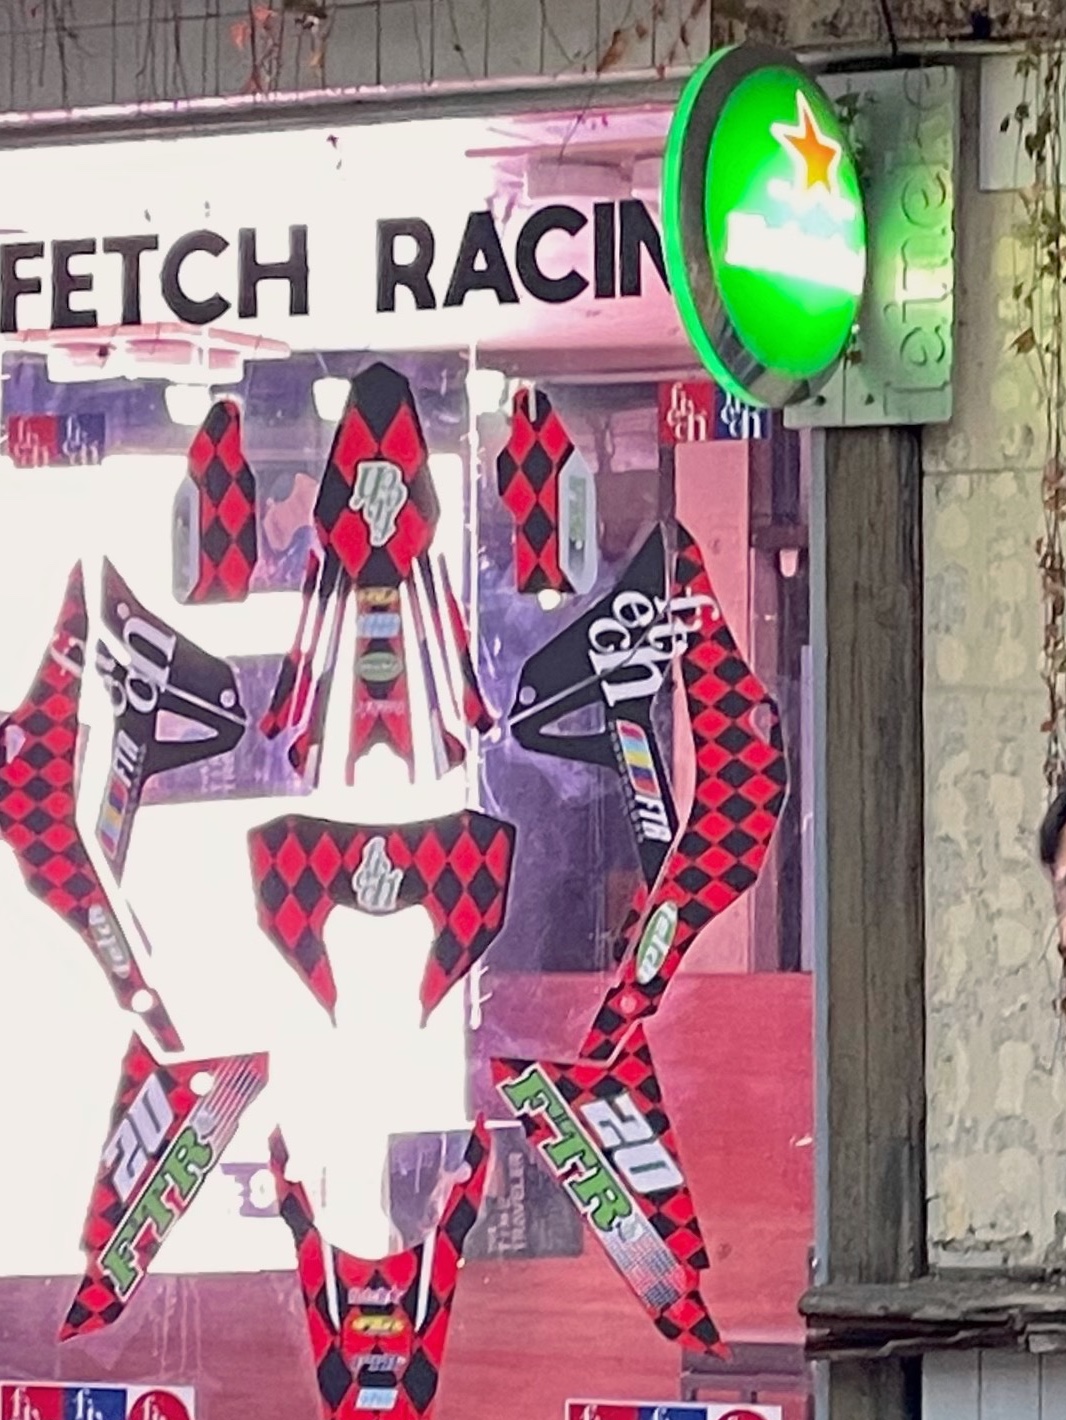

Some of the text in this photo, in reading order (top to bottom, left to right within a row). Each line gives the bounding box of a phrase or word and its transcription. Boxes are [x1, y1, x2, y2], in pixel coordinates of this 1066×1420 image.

[0, 224, 309, 333] FETCH
[103, 1072, 175, 1202] 20
[498, 1063, 633, 1233] FTR
[580, 1089, 685, 1193] 20
[99, 1124, 215, 1299] FTR
